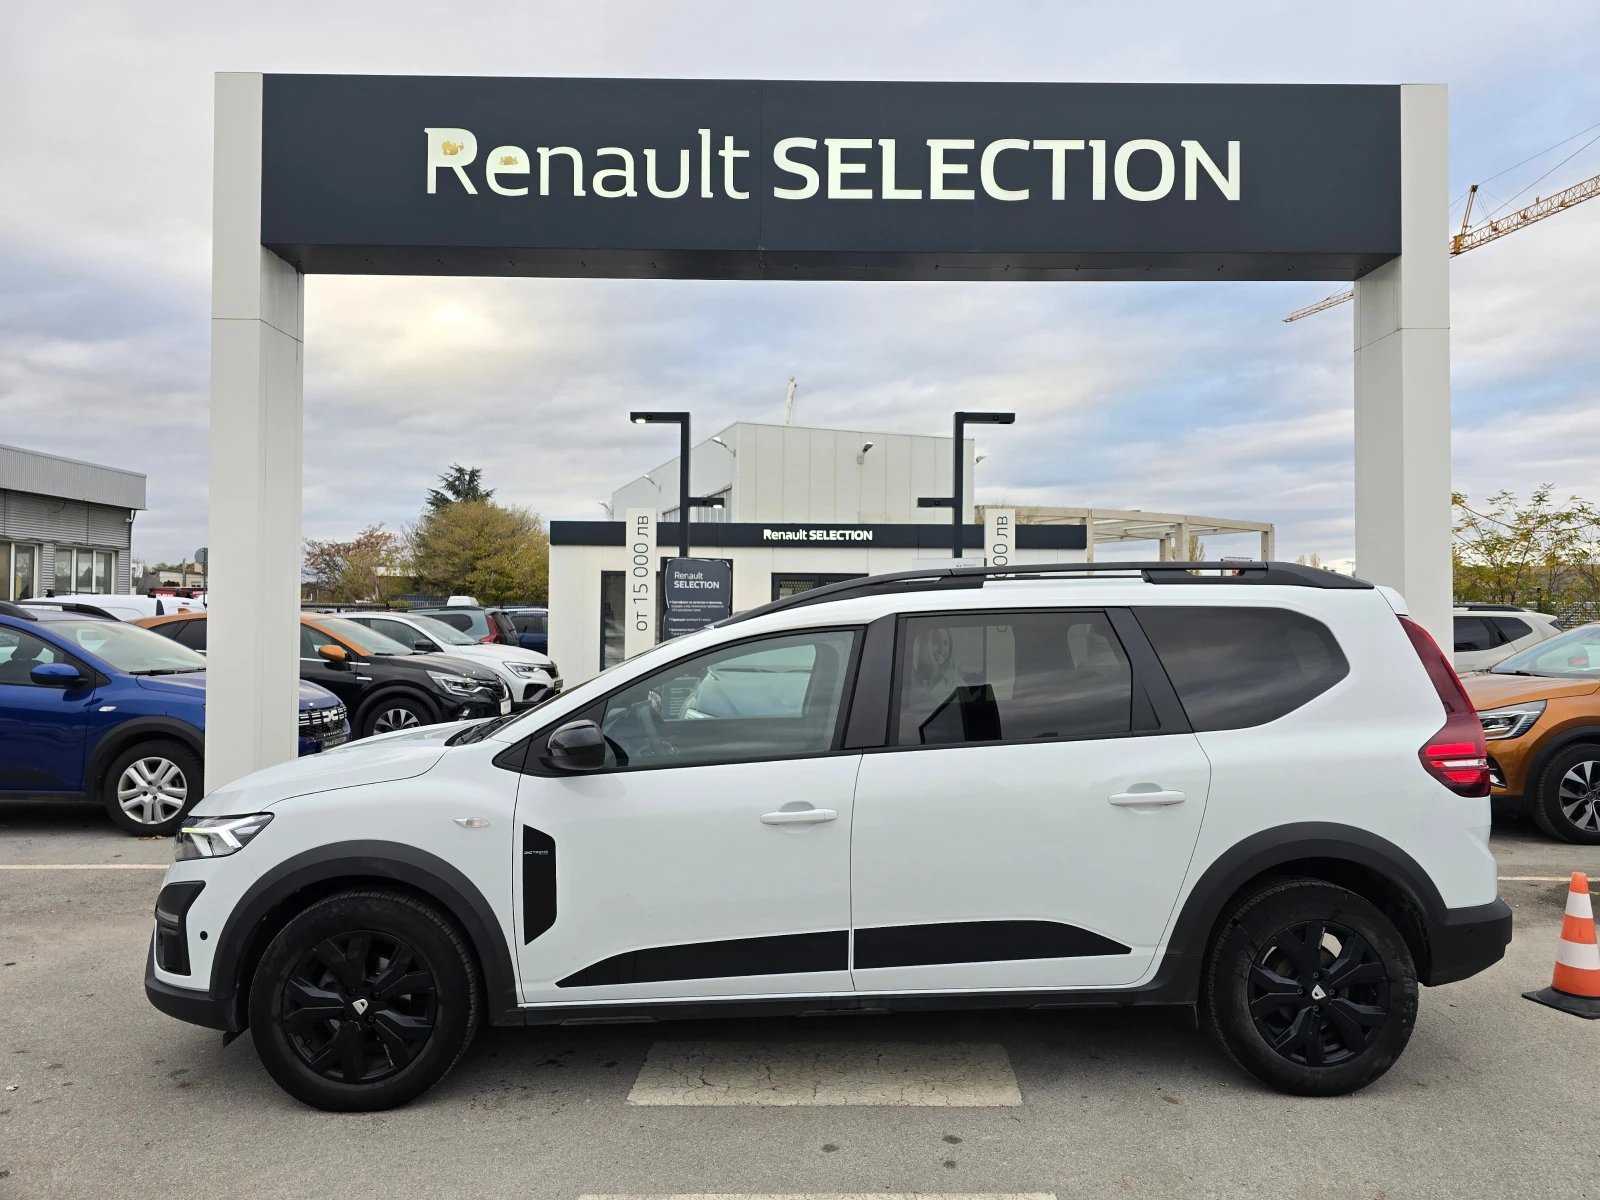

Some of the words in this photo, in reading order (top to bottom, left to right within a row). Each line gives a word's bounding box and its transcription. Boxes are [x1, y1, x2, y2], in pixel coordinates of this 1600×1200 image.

[424, 128, 750, 199] Renault
[773, 137, 1241, 202] SELECTION
[763, 529, 807, 540] Renault
[808, 530, 873, 541] SELECTION
[632, 542, 648, 578] 000
[674, 571, 704, 580] Renault
[674, 580, 720, 589] SELECTION
[632, 583, 648, 605] 15
